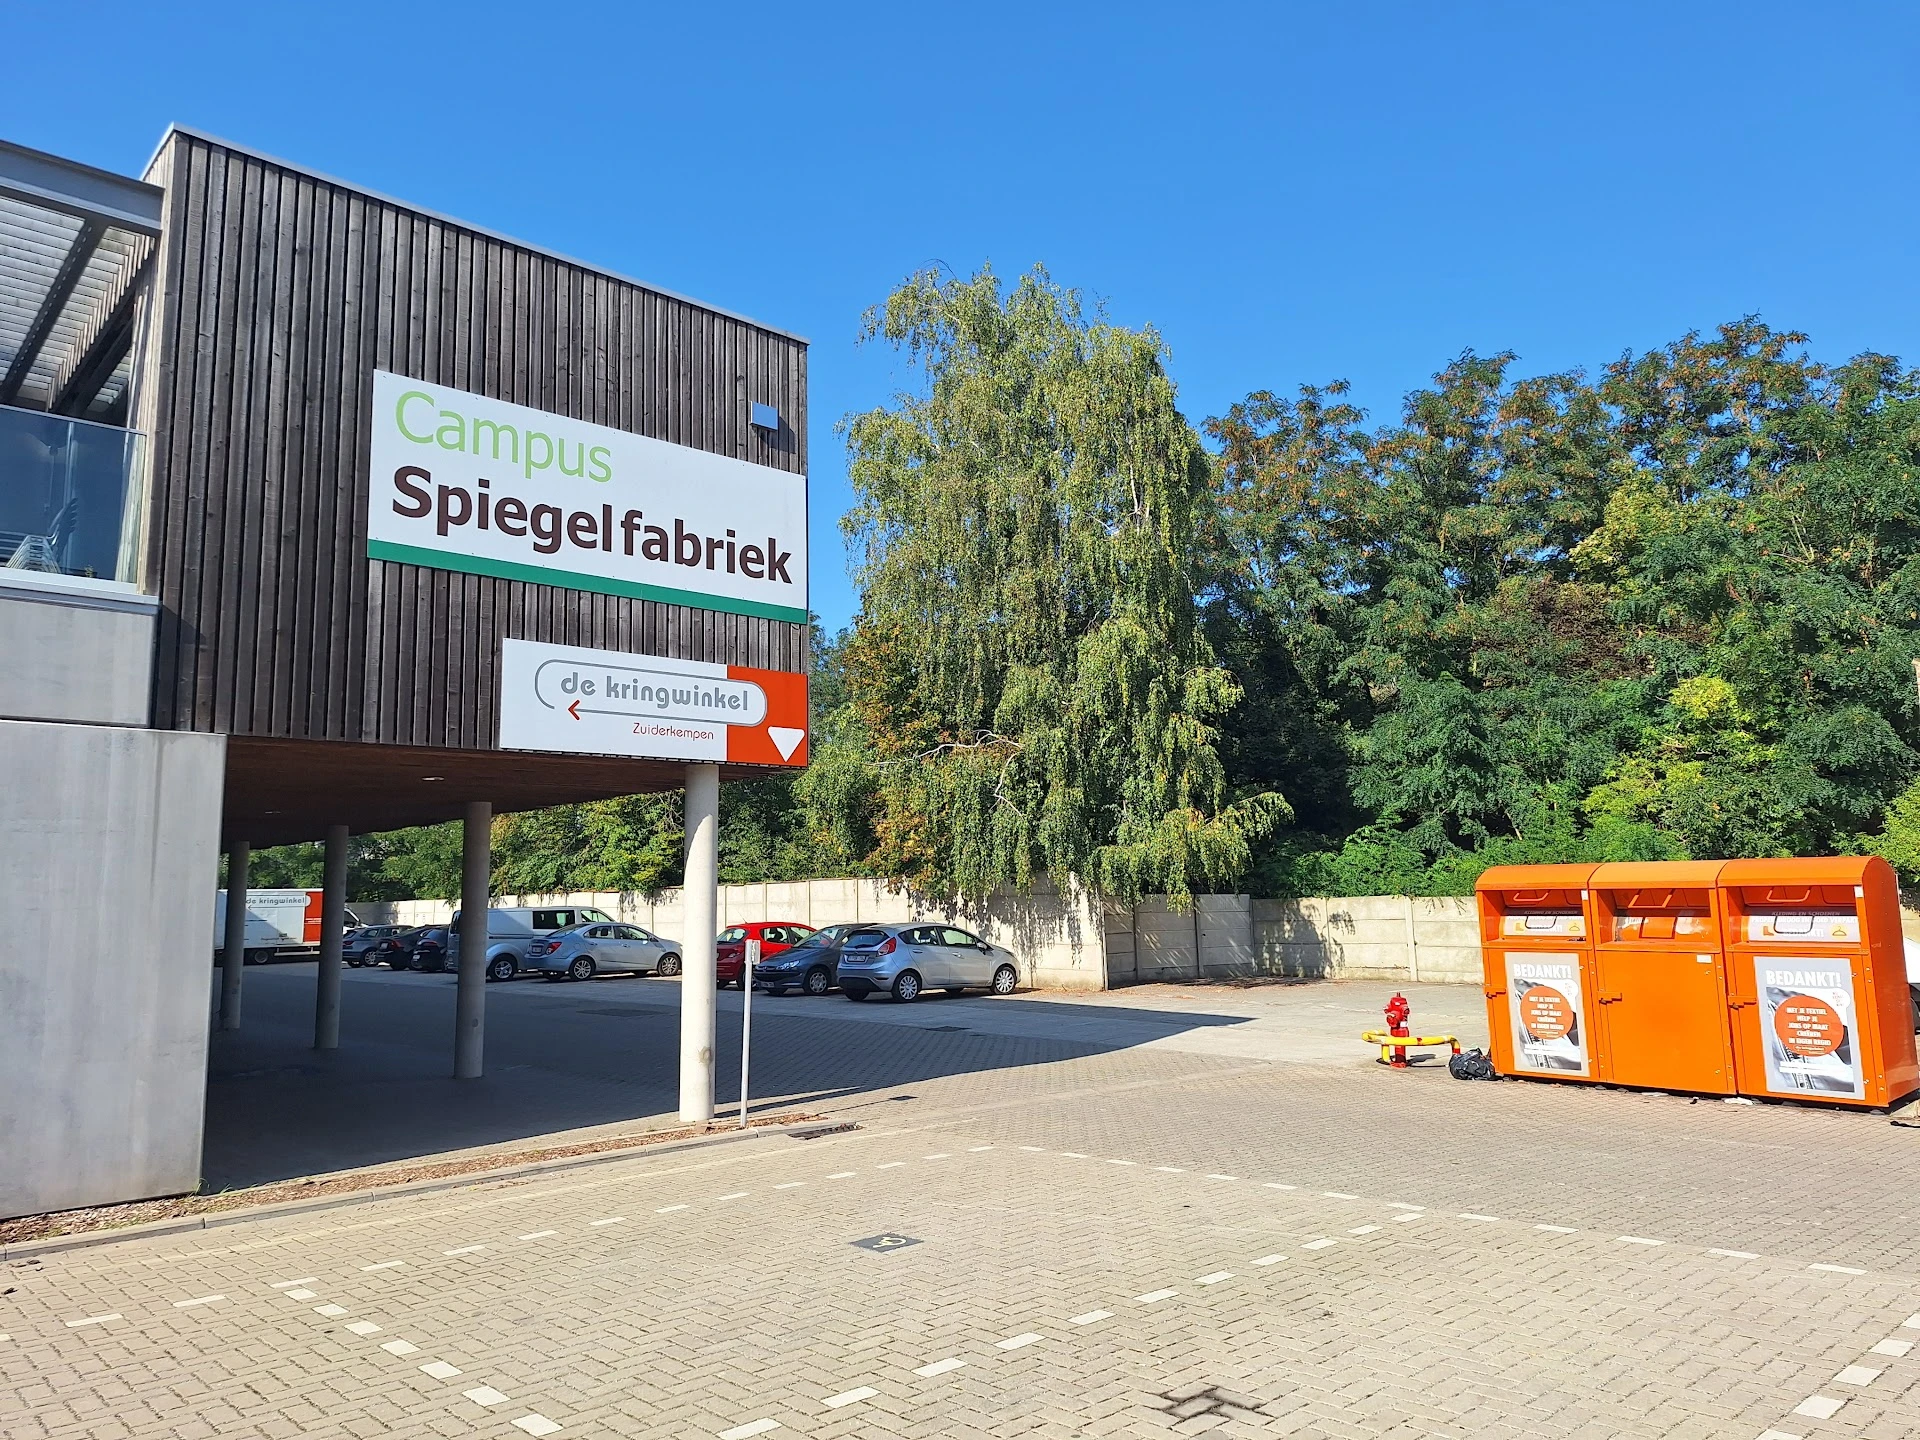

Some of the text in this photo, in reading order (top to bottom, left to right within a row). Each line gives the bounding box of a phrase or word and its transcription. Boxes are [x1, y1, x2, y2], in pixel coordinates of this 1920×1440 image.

[395, 391, 612, 483] Campus
[392, 465, 792, 584] Spiegelfabriek
[561, 672, 748, 710] de kringwinkel
[633, 722, 714, 741] Zuiderkempen
[259, 897, 305, 905] kringwinkel
[1514, 964, 1572, 978] BEDANKT!
[1766, 970, 1841, 987] BEDANKT!
